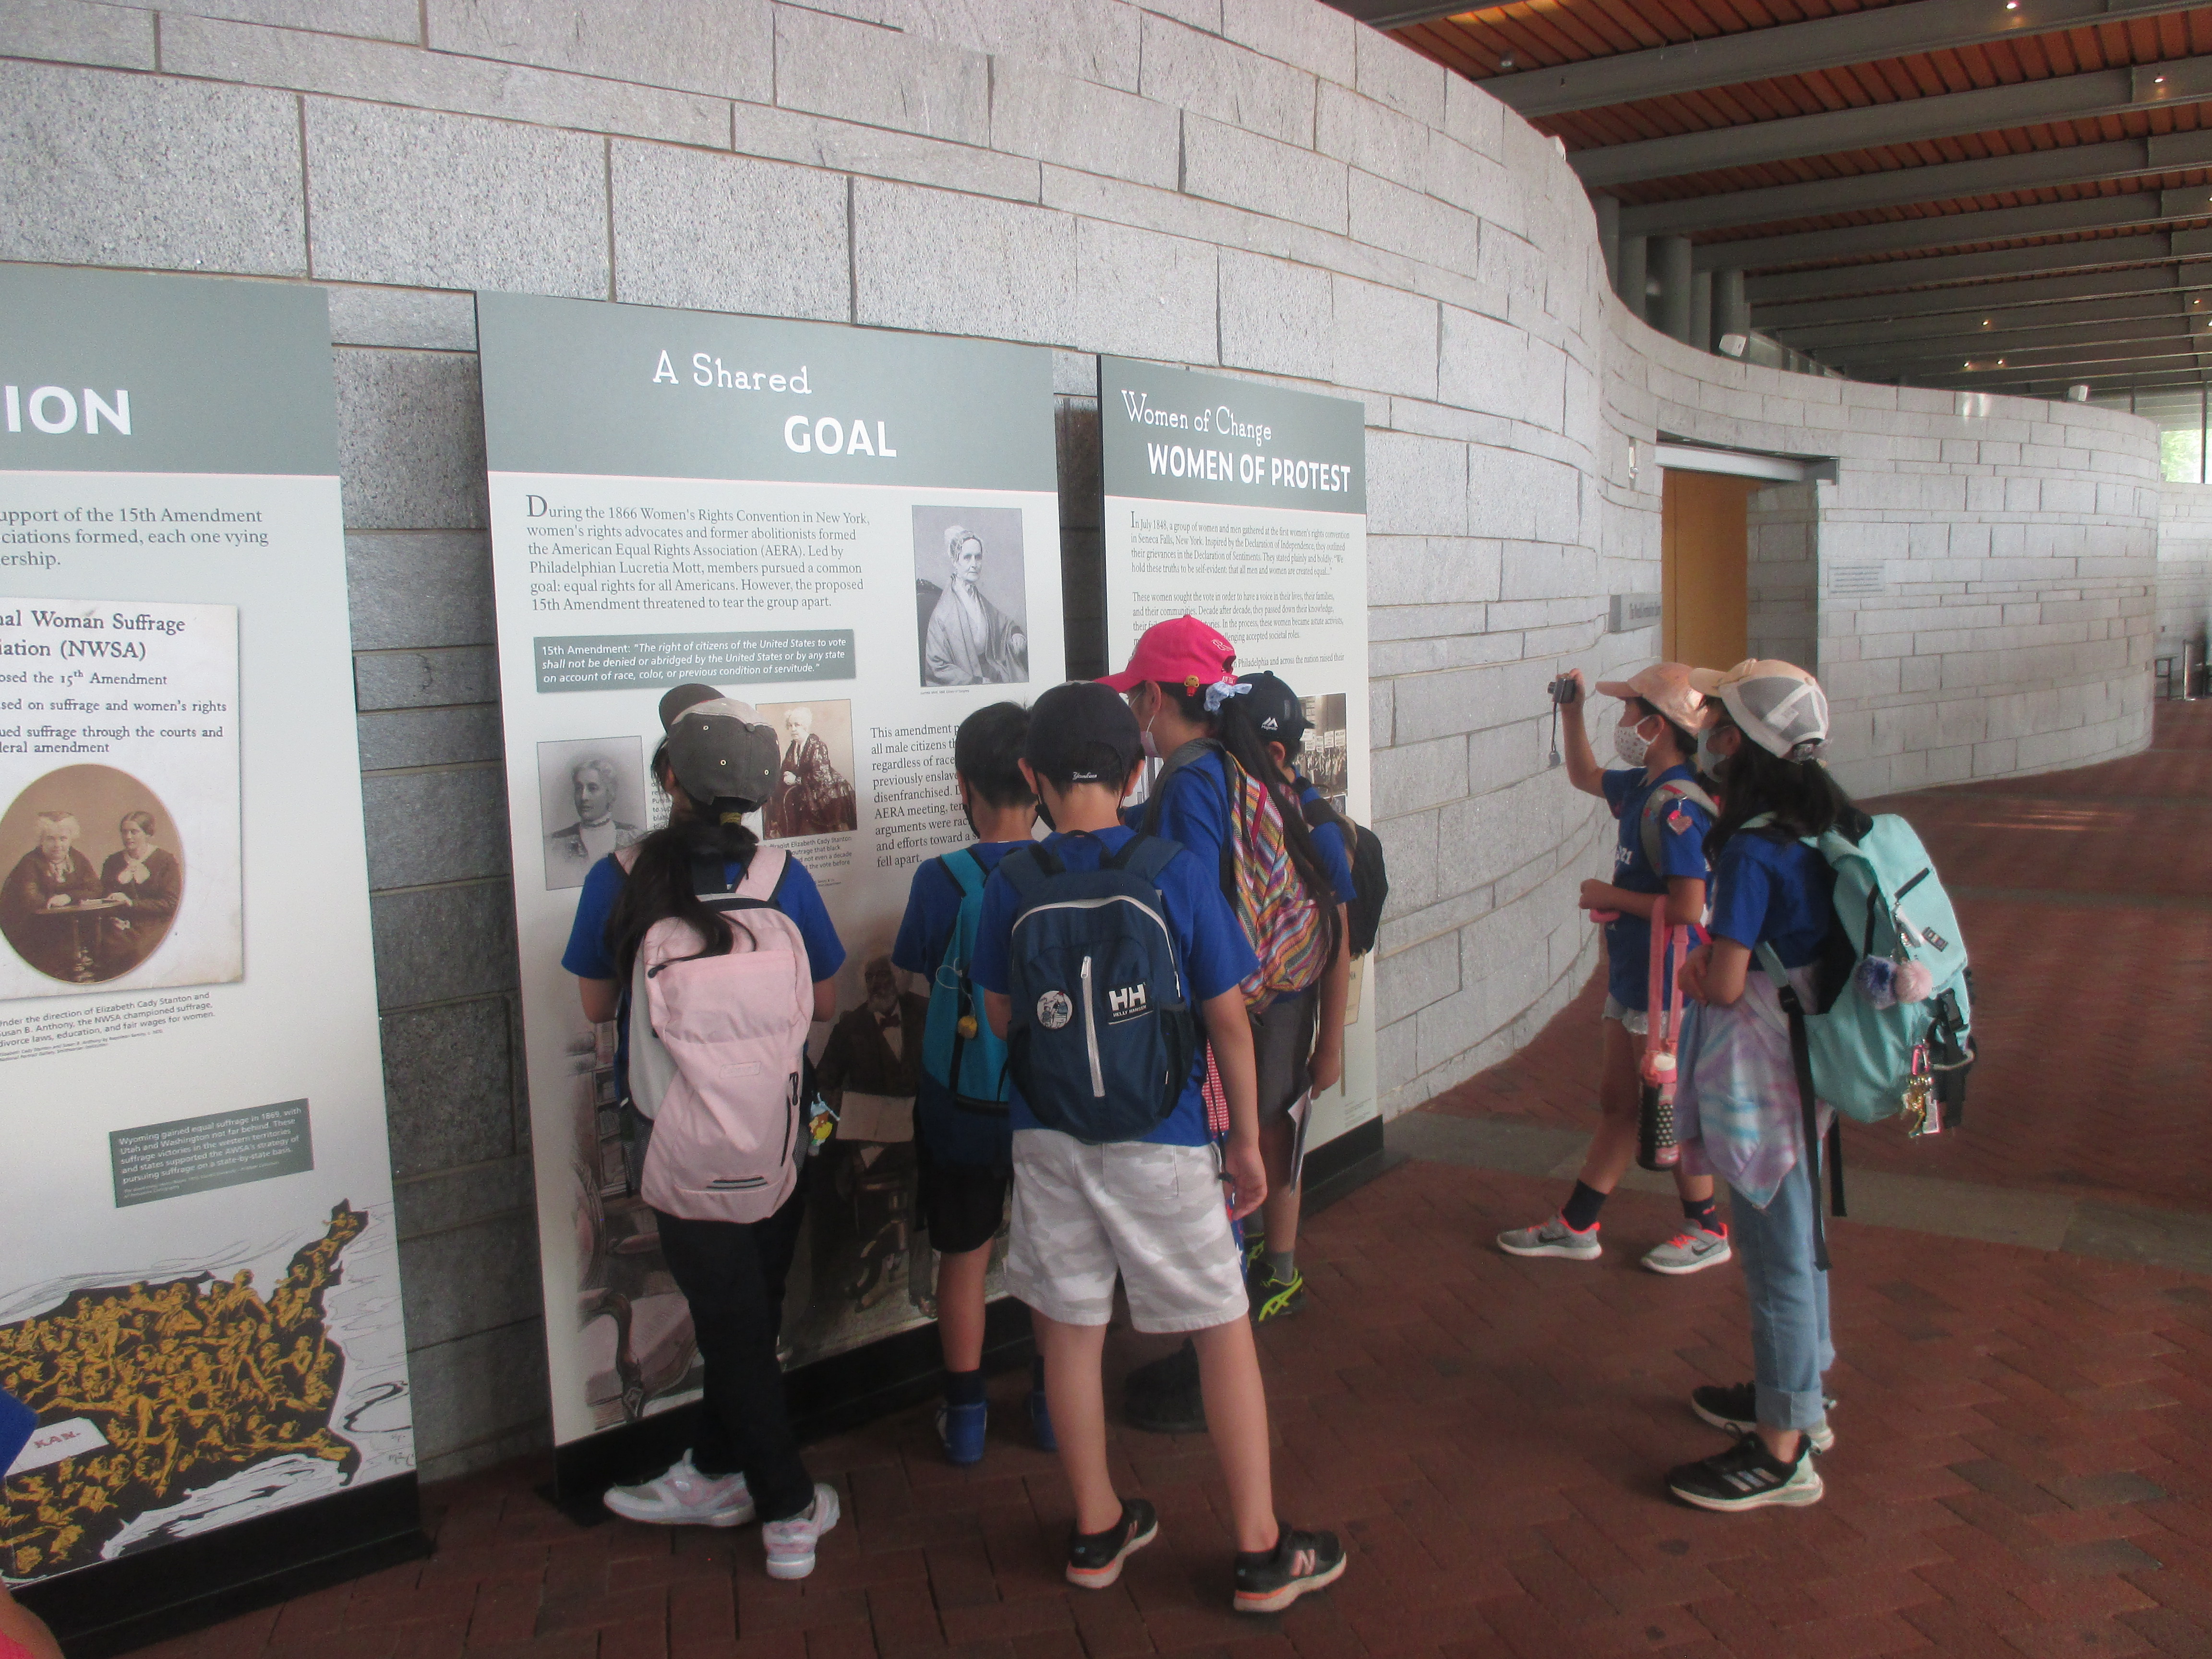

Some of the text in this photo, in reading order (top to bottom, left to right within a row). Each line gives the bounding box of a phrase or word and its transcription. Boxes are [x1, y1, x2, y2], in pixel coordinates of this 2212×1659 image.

[653, 349, 812, 395] A Shared
[6, 385, 132, 435] ION
[1121, 390, 1272, 446] Women of Change
[784, 415, 897, 457] GOAL
[1147, 443, 1351, 492] WOMEN OF PROTEST
[64, 507, 82, 521] of
[87, 507, 113, 522] the
[121, 508, 156, 522] 15th
[161, 508, 262, 522] Amendment
[526, 495, 869, 524] During the 1866 Women's Rights Convention in New York,
[1131, 511, 1139, 528] In
[1141, 518, 1152, 532] July
[1154, 519, 1168, 531] 1848,
[1174, 523, 1190, 534] group
[1191, 521, 1197, 531] of
[1219, 524, 1229, 533] and
[76, 529, 144, 544] formed,
[148, 529, 185, 543] each
[191, 533, 220, 542] one
[225, 530, 268, 547] vying
[527, 524, 855, 541] women's rights advocates and former abolitionists formed
[529, 542, 843, 559] the American Equal Rights Association (AERA). Led by
[530, 561, 616, 577] Philadelphian
[620, 562, 669, 573] Lucretia
[673, 562, 704, 575] Mott,
[708, 561, 758, 573] members
[762, 562, 805, 576] pursued
[531, 578, 863, 596] goal: equal rights for all Americans. However, the proposed
[533, 596, 831, 611] 15th Amendment threatened to tear the group apart.
[31, 610, 104, 629] Woman
[113, 613, 185, 636] Suffrage
[61, 640, 145, 661] (NWSA)
[542, 646, 564, 655] 15th
[567, 644, 630, 654] Amendment:
[659, 642, 681, 654] right
[684, 641, 694, 650] of
[696, 641, 728, 650] citizens
[731, 640, 741, 649] of
[743, 640, 757, 649] the
[760, 638, 788, 648] United
[791, 639, 815, 648] States
[542, 659, 565, 669] shall
[568, 659, 585, 668] not
[588, 658, 600, 667] be
[603, 656, 636, 667] denied
[651, 655, 692, 666] abridged
[695, 654, 706, 665] by
[709, 654, 722, 663] the
[726, 652, 755, 662] United
[757, 653, 782, 661] States
[796, 650, 806, 662] by
[808, 652, 823, 661] any
[825, 650, 844, 659] state
[34, 671, 54, 683] the
[89, 673, 167, 685] Amendment
[560, 673, 598, 682] account
[601, 671, 612, 681] of
[639, 669, 663, 679] color,
[679, 668, 717, 679] previous
[720, 665, 760, 675] condition
[775, 663, 819, 673] servitude."
[28, 702, 44, 710] on
[50, 698, 99, 713] suffrage
[106, 699, 128, 710] and
[133, 699, 186, 711] women's
[192, 700, 226, 714] rights
[27, 725, 76, 740] suffrage
[83, 725, 130, 740] through
[136, 725, 155, 737] the
[160, 728, 196, 737] courts
[202, 726, 223, 737] and
[870, 724, 951, 738] This amendment
[35, 741, 109, 753] amendment
[872, 740, 946, 755] all male citizens
[43, 1011, 82, 1021] direction
[96, 1002, 135, 1013] Elizabeth
[137, 999, 157, 1008] Cady
[160, 996, 192, 1005] Stanton
[194, 992, 209, 1000] and
[1109, 984, 1146, 1011] HH
[1129, 1005, 1147, 1014] HANSEN
